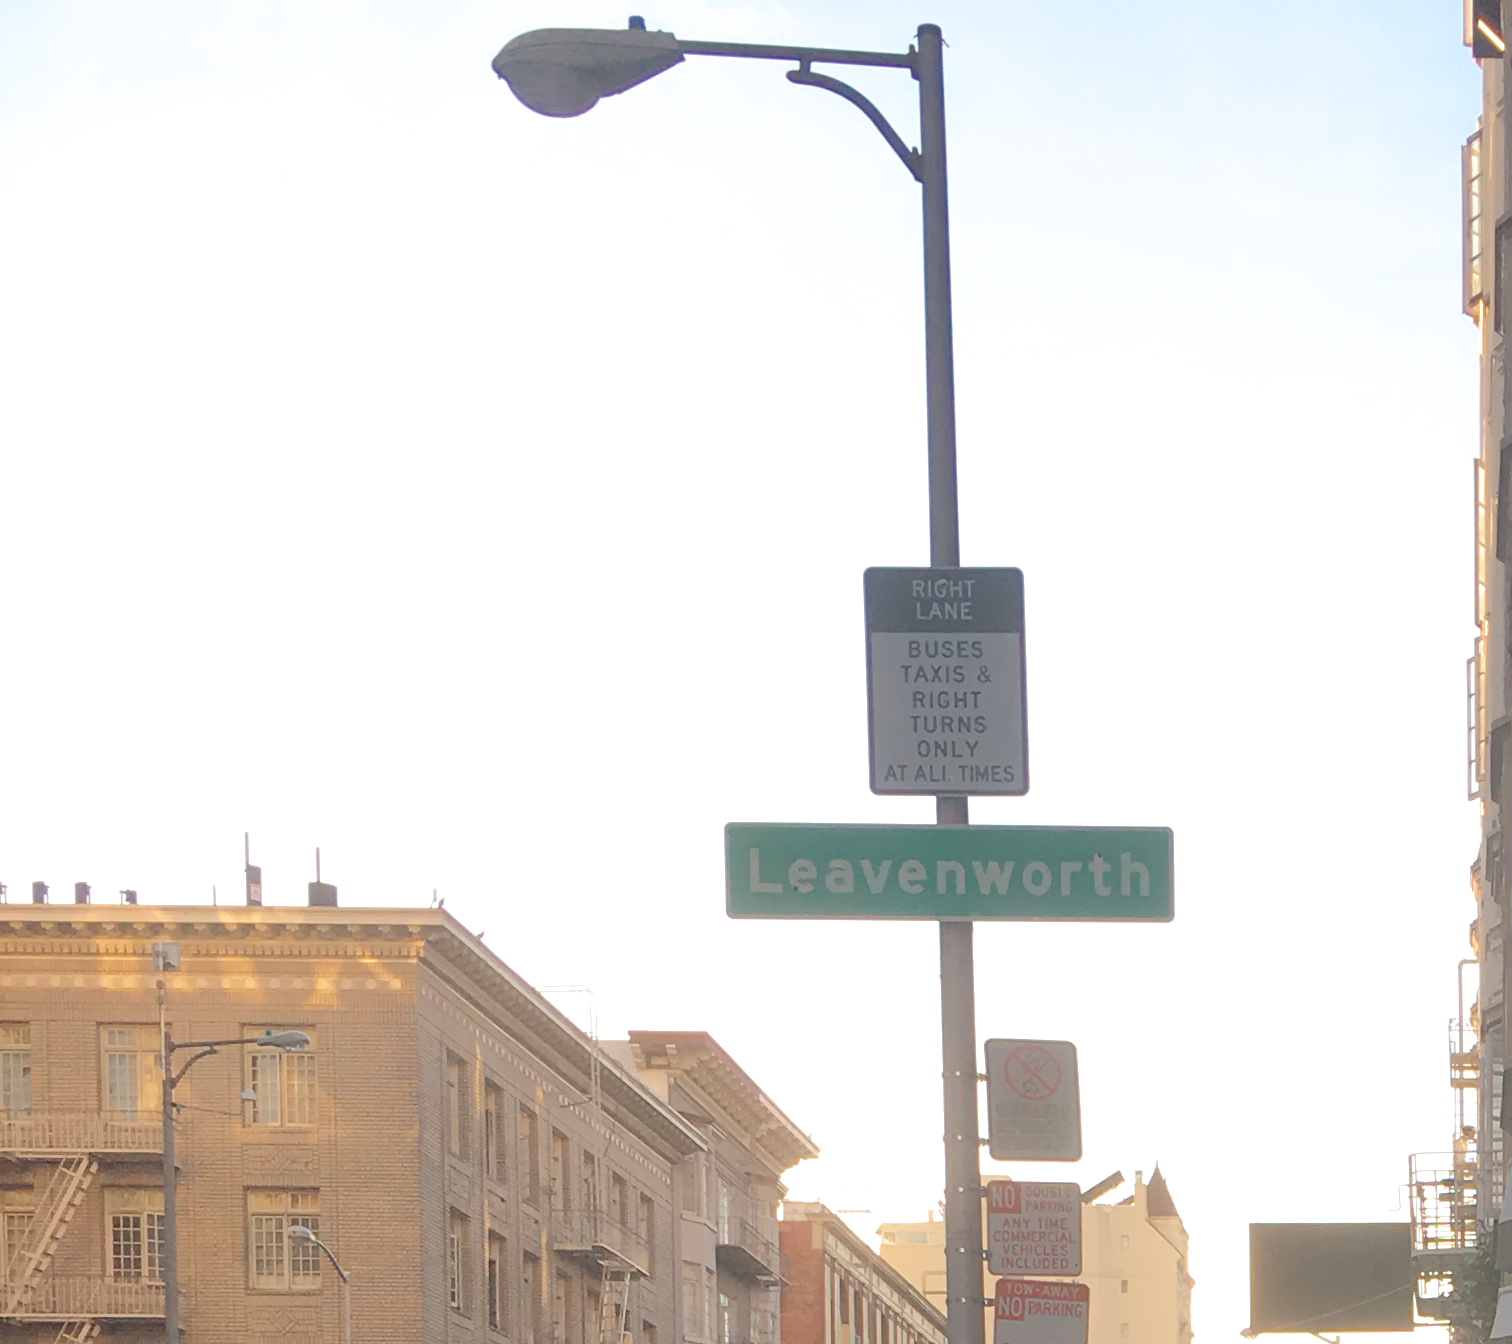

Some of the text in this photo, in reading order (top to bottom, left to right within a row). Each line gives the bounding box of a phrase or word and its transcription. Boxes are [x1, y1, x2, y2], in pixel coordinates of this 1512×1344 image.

[912, 580, 975, 599] RIGHT
[916, 603, 973, 621] LANE
[908, 641, 983, 659] BUSES
[901, 666, 992, 683] TAXIS &
[912, 691, 982, 709] RIGHT
[910, 716, 987, 734] TURNS
[917, 741, 979, 758] ONLY
[884, 765, 907, 782] AT
[960, 766, 1015, 783] TIMES
[748, 847, 1151, 897] Leavenworth
[992, 1185, 1072, 1209] NO DOUBLE
[1026, 1201, 1072, 1213] PARKING
[1002, 1217, 1068, 1230] ANY TIME
[993, 1230, 1076, 1243] COMMERCIAL
[1002, 1244, 1068, 1256] VEHICLES
[1001, 1258, 1069, 1270] INCLUDED
[1006, 1282, 1080, 1298] TOW-AWAY
[998, 1296, 1083, 1318] NO PARKING
